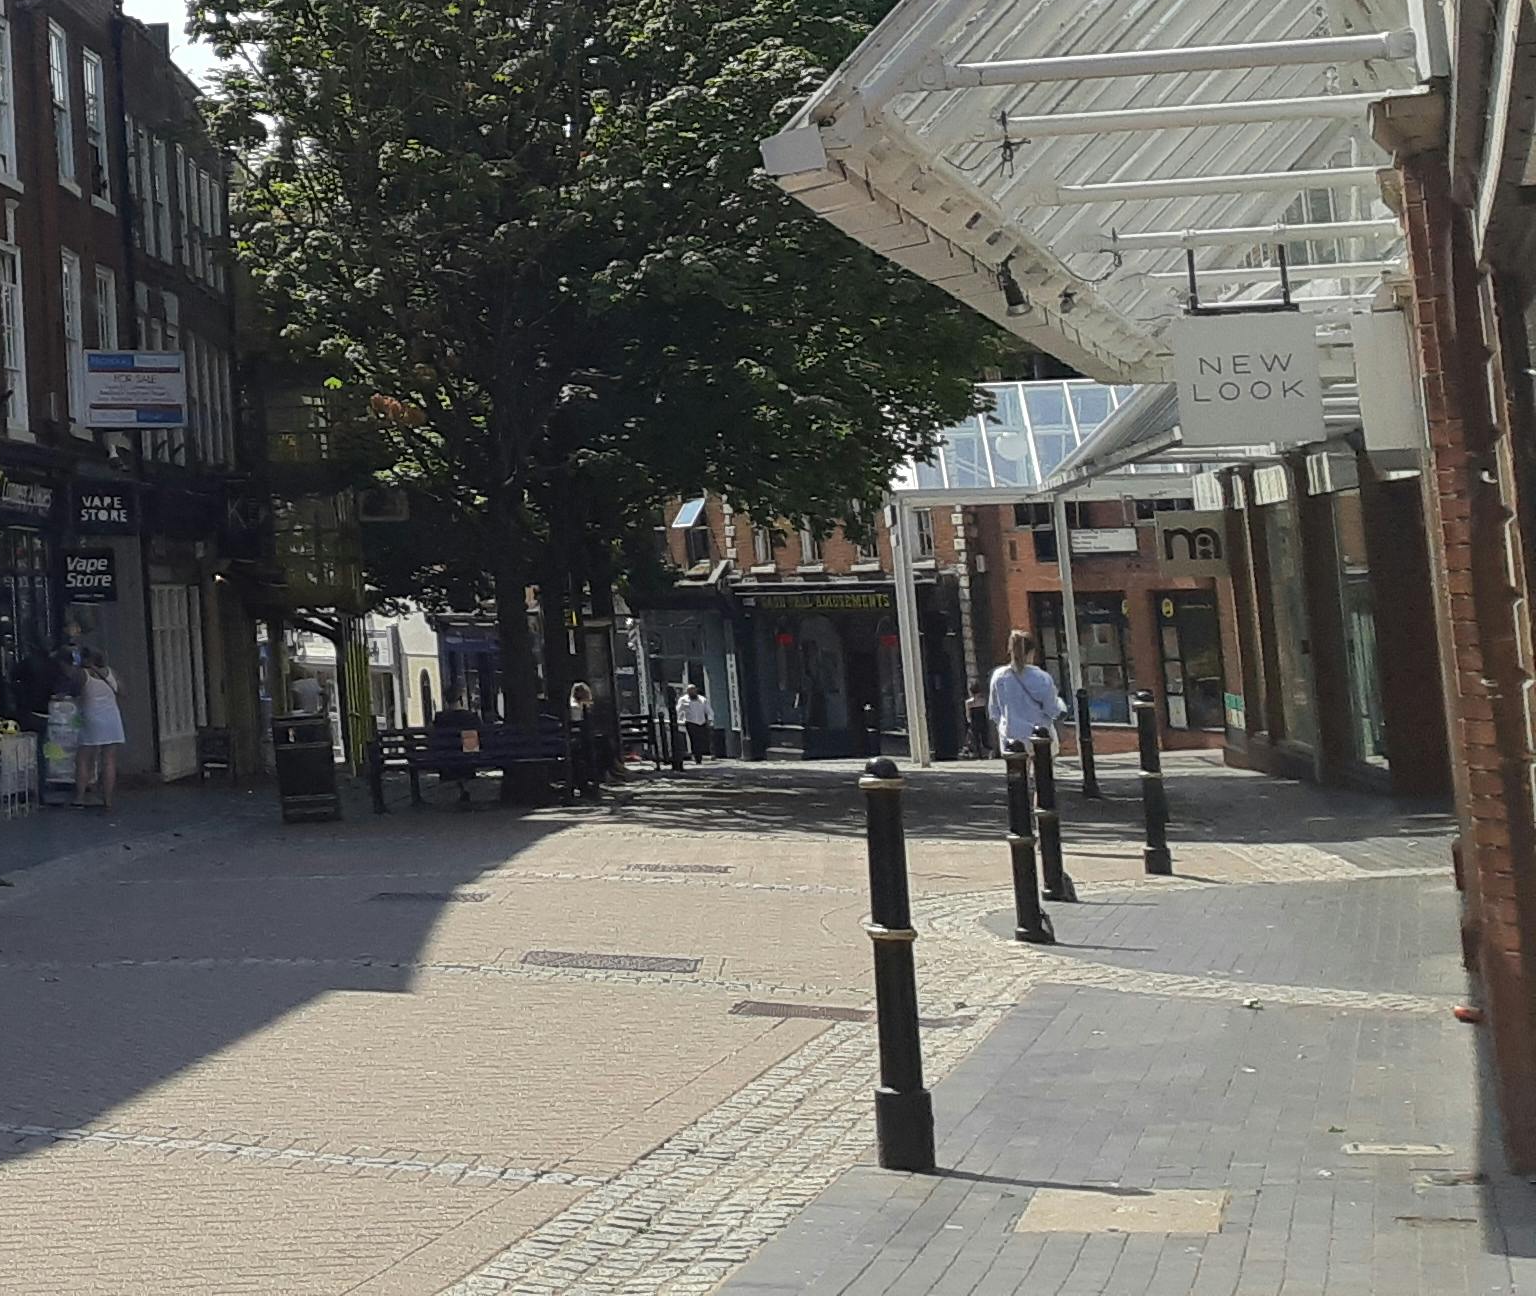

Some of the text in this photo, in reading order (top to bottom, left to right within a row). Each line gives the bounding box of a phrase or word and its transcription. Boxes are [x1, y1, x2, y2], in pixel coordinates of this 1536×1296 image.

[1198, 353, 1292, 376] NEW
[1192, 379, 1305, 403] LOOK
[81, 495, 123, 509] VAPE
[80, 508, 129, 523] STORE
[66, 556, 108, 573] Vape
[65, 572, 113, 588] Store
[815, 593, 890, 608] AMUSEMENTS
